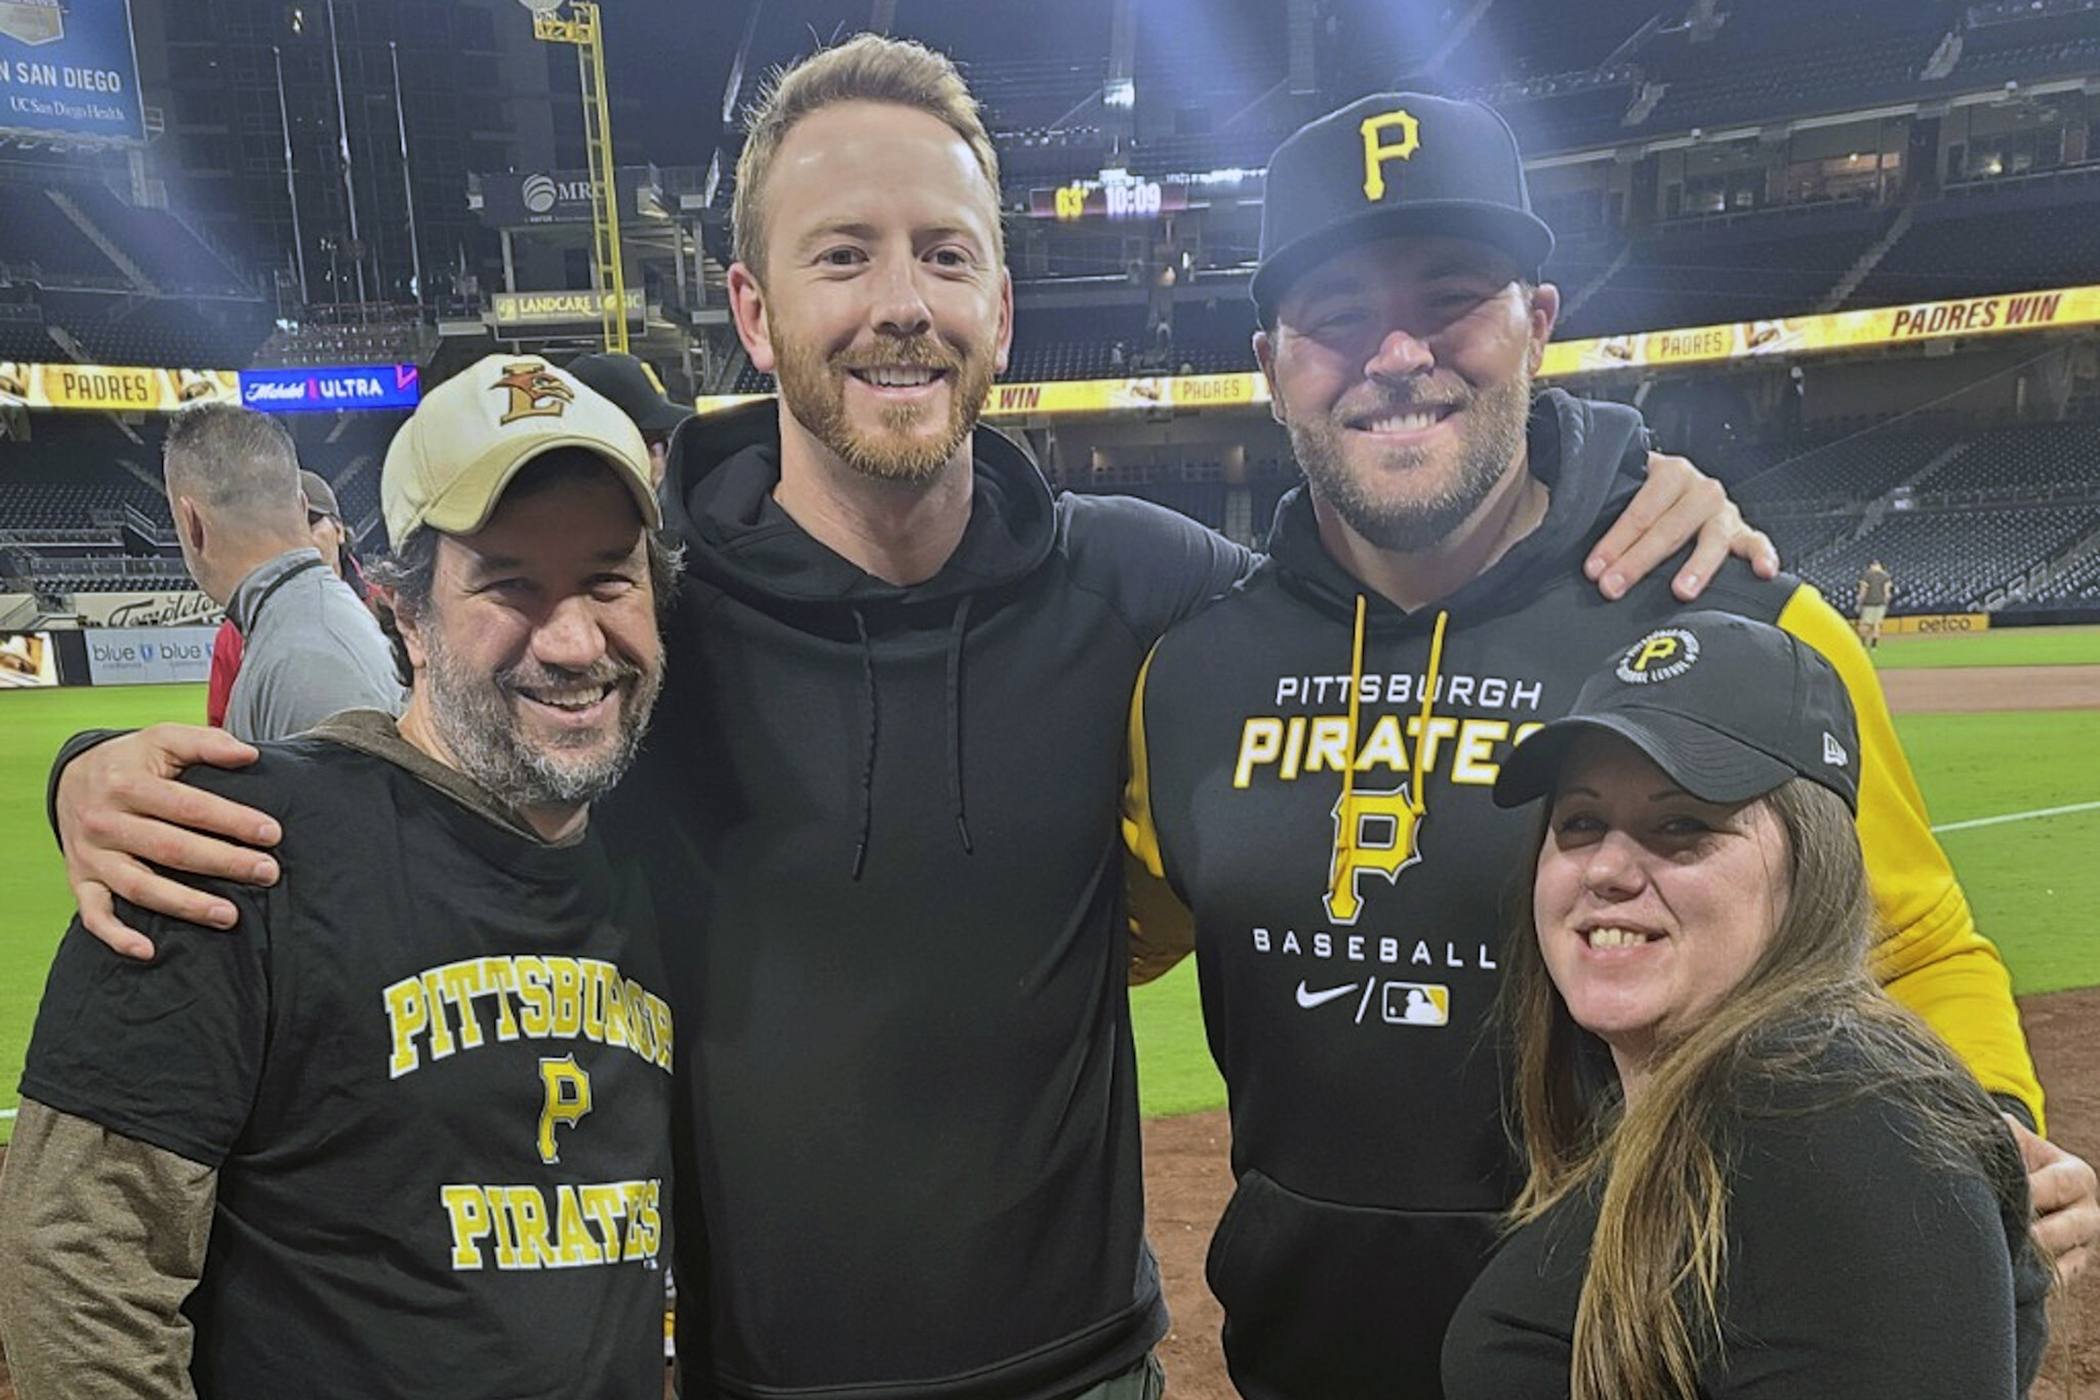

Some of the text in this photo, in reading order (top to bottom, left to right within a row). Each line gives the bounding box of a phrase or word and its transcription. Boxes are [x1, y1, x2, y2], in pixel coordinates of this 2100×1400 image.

[16, 62, 57, 87] SAN
[63, 66, 121, 93] DIEGO
[1360, 109, 1420, 201] P
[1105, 183, 1161, 216] 10:09
[1890, 292, 2062, 337] PADRES WIN
[1661, 331, 1723, 358] PADRES
[63, 372, 148, 402] PADRES
[320, 378, 384, 397] ULTRA
[1000, 387, 1040, 409] WIN
[1183, 379, 1240, 400] PADRES
[92, 643, 135, 661] blue
[160, 642, 201, 660] blue
[1633, 637, 1677, 671] P
[1275, 673, 1543, 710] PITTSBURGH
[1322, 782, 1425, 925] P
[1252, 927, 1497, 970] BASEBALL
[536, 1052, 593, 1164] P
[440, 1180, 661, 1269] PIRATES
